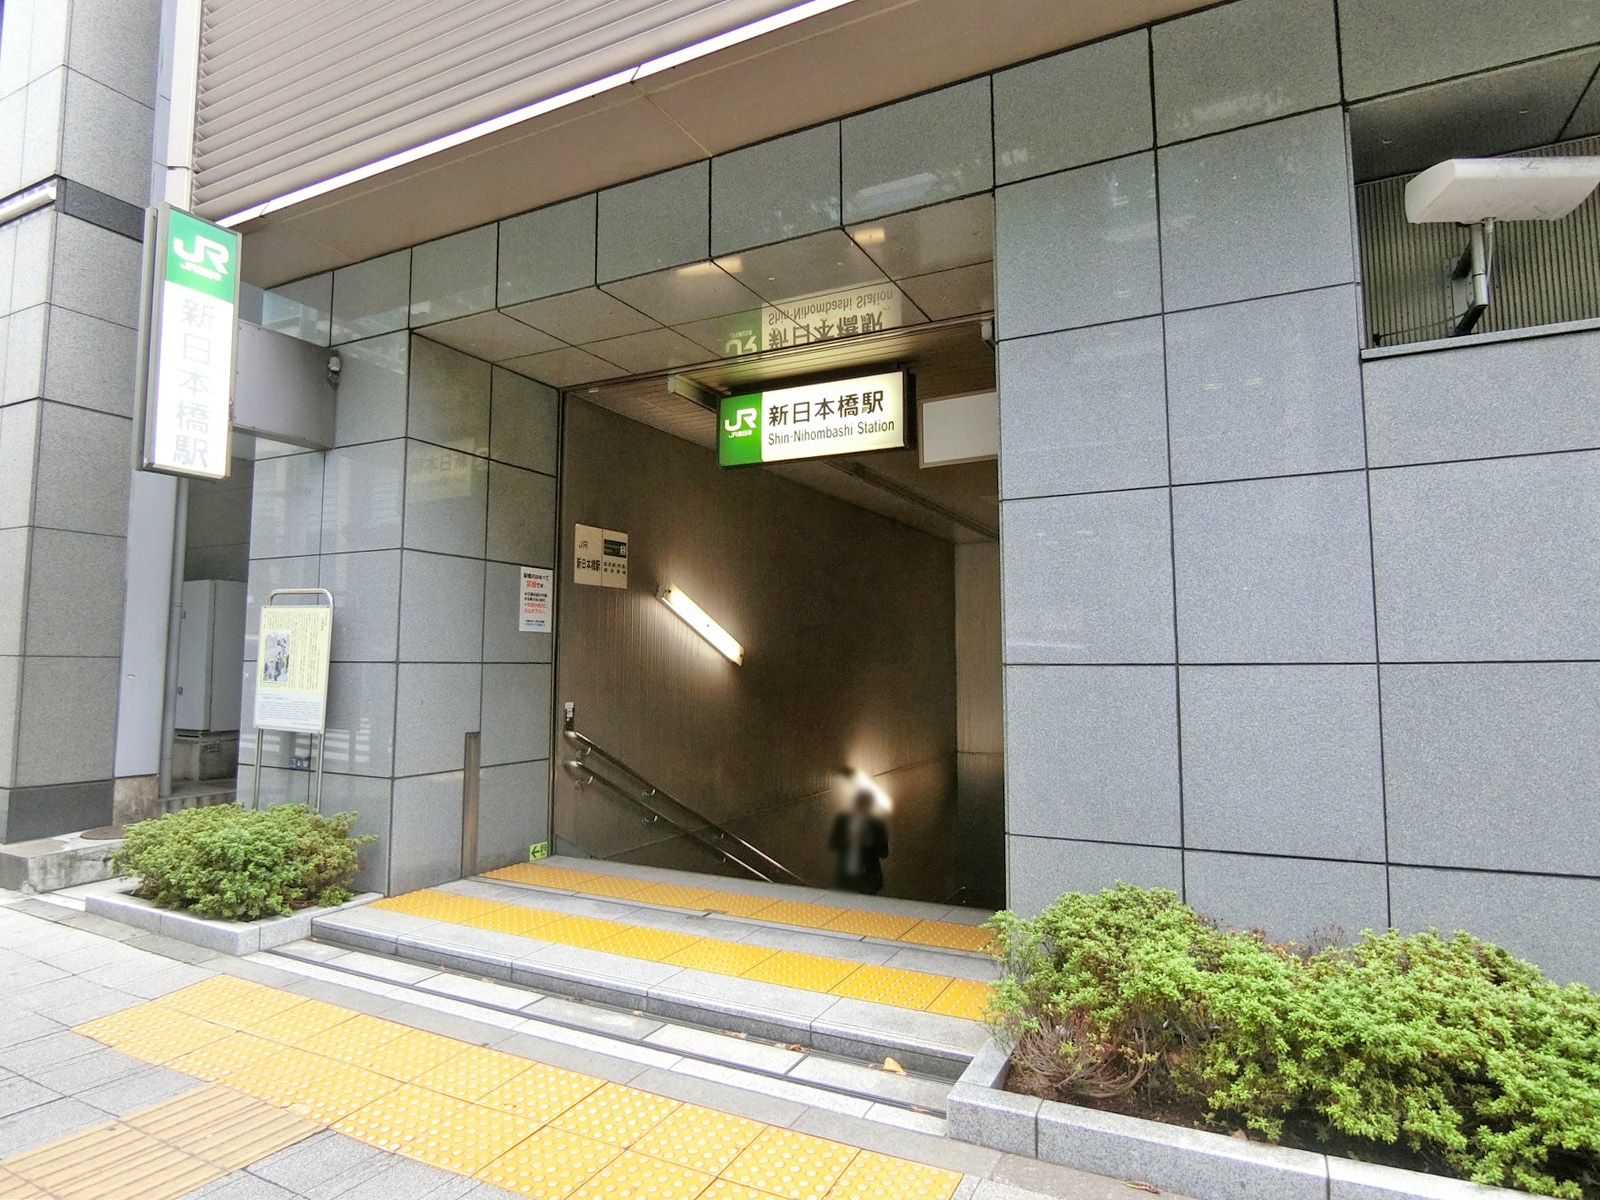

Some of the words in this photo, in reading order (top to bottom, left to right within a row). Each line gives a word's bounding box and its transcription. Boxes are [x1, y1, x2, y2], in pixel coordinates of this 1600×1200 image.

[173, 235, 229, 275] JR
[173, 298, 216, 468] 新日本橋駅
[724, 407, 758, 432] JR
[768, 390, 884, 427] 新日本橋駅
[768, 424, 853, 446] Shin-Nihombashi
[857, 420, 895, 435] Station
[578, 540, 589, 550] JR
[576, 557, 601, 572] 新日本橋駅
